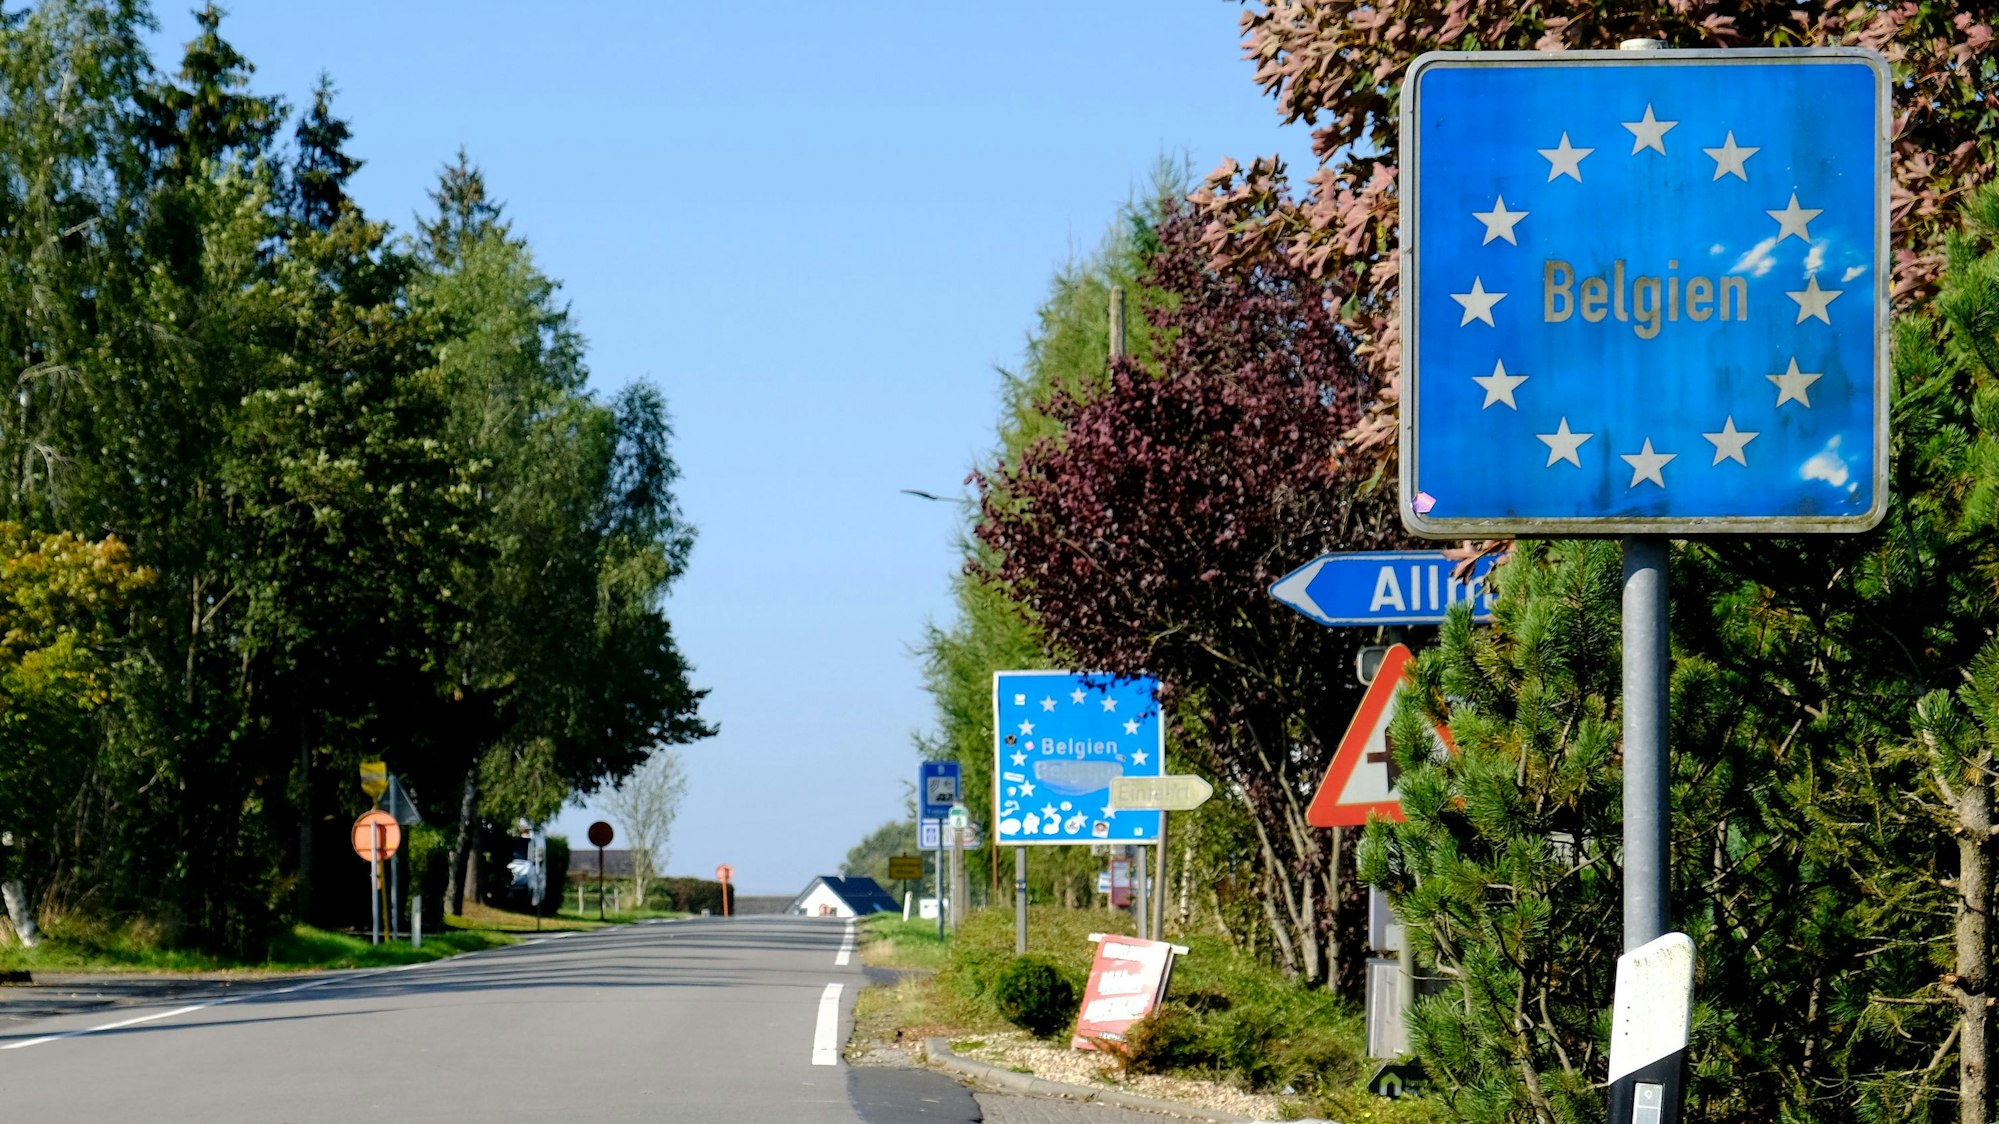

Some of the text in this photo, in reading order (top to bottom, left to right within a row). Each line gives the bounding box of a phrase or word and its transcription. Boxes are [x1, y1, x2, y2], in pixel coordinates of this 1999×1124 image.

[1543, 259, 1748, 339] Belgien
[1041, 737, 1118, 760] Belgien
[1118, 782, 1190, 802] Einfahrt
